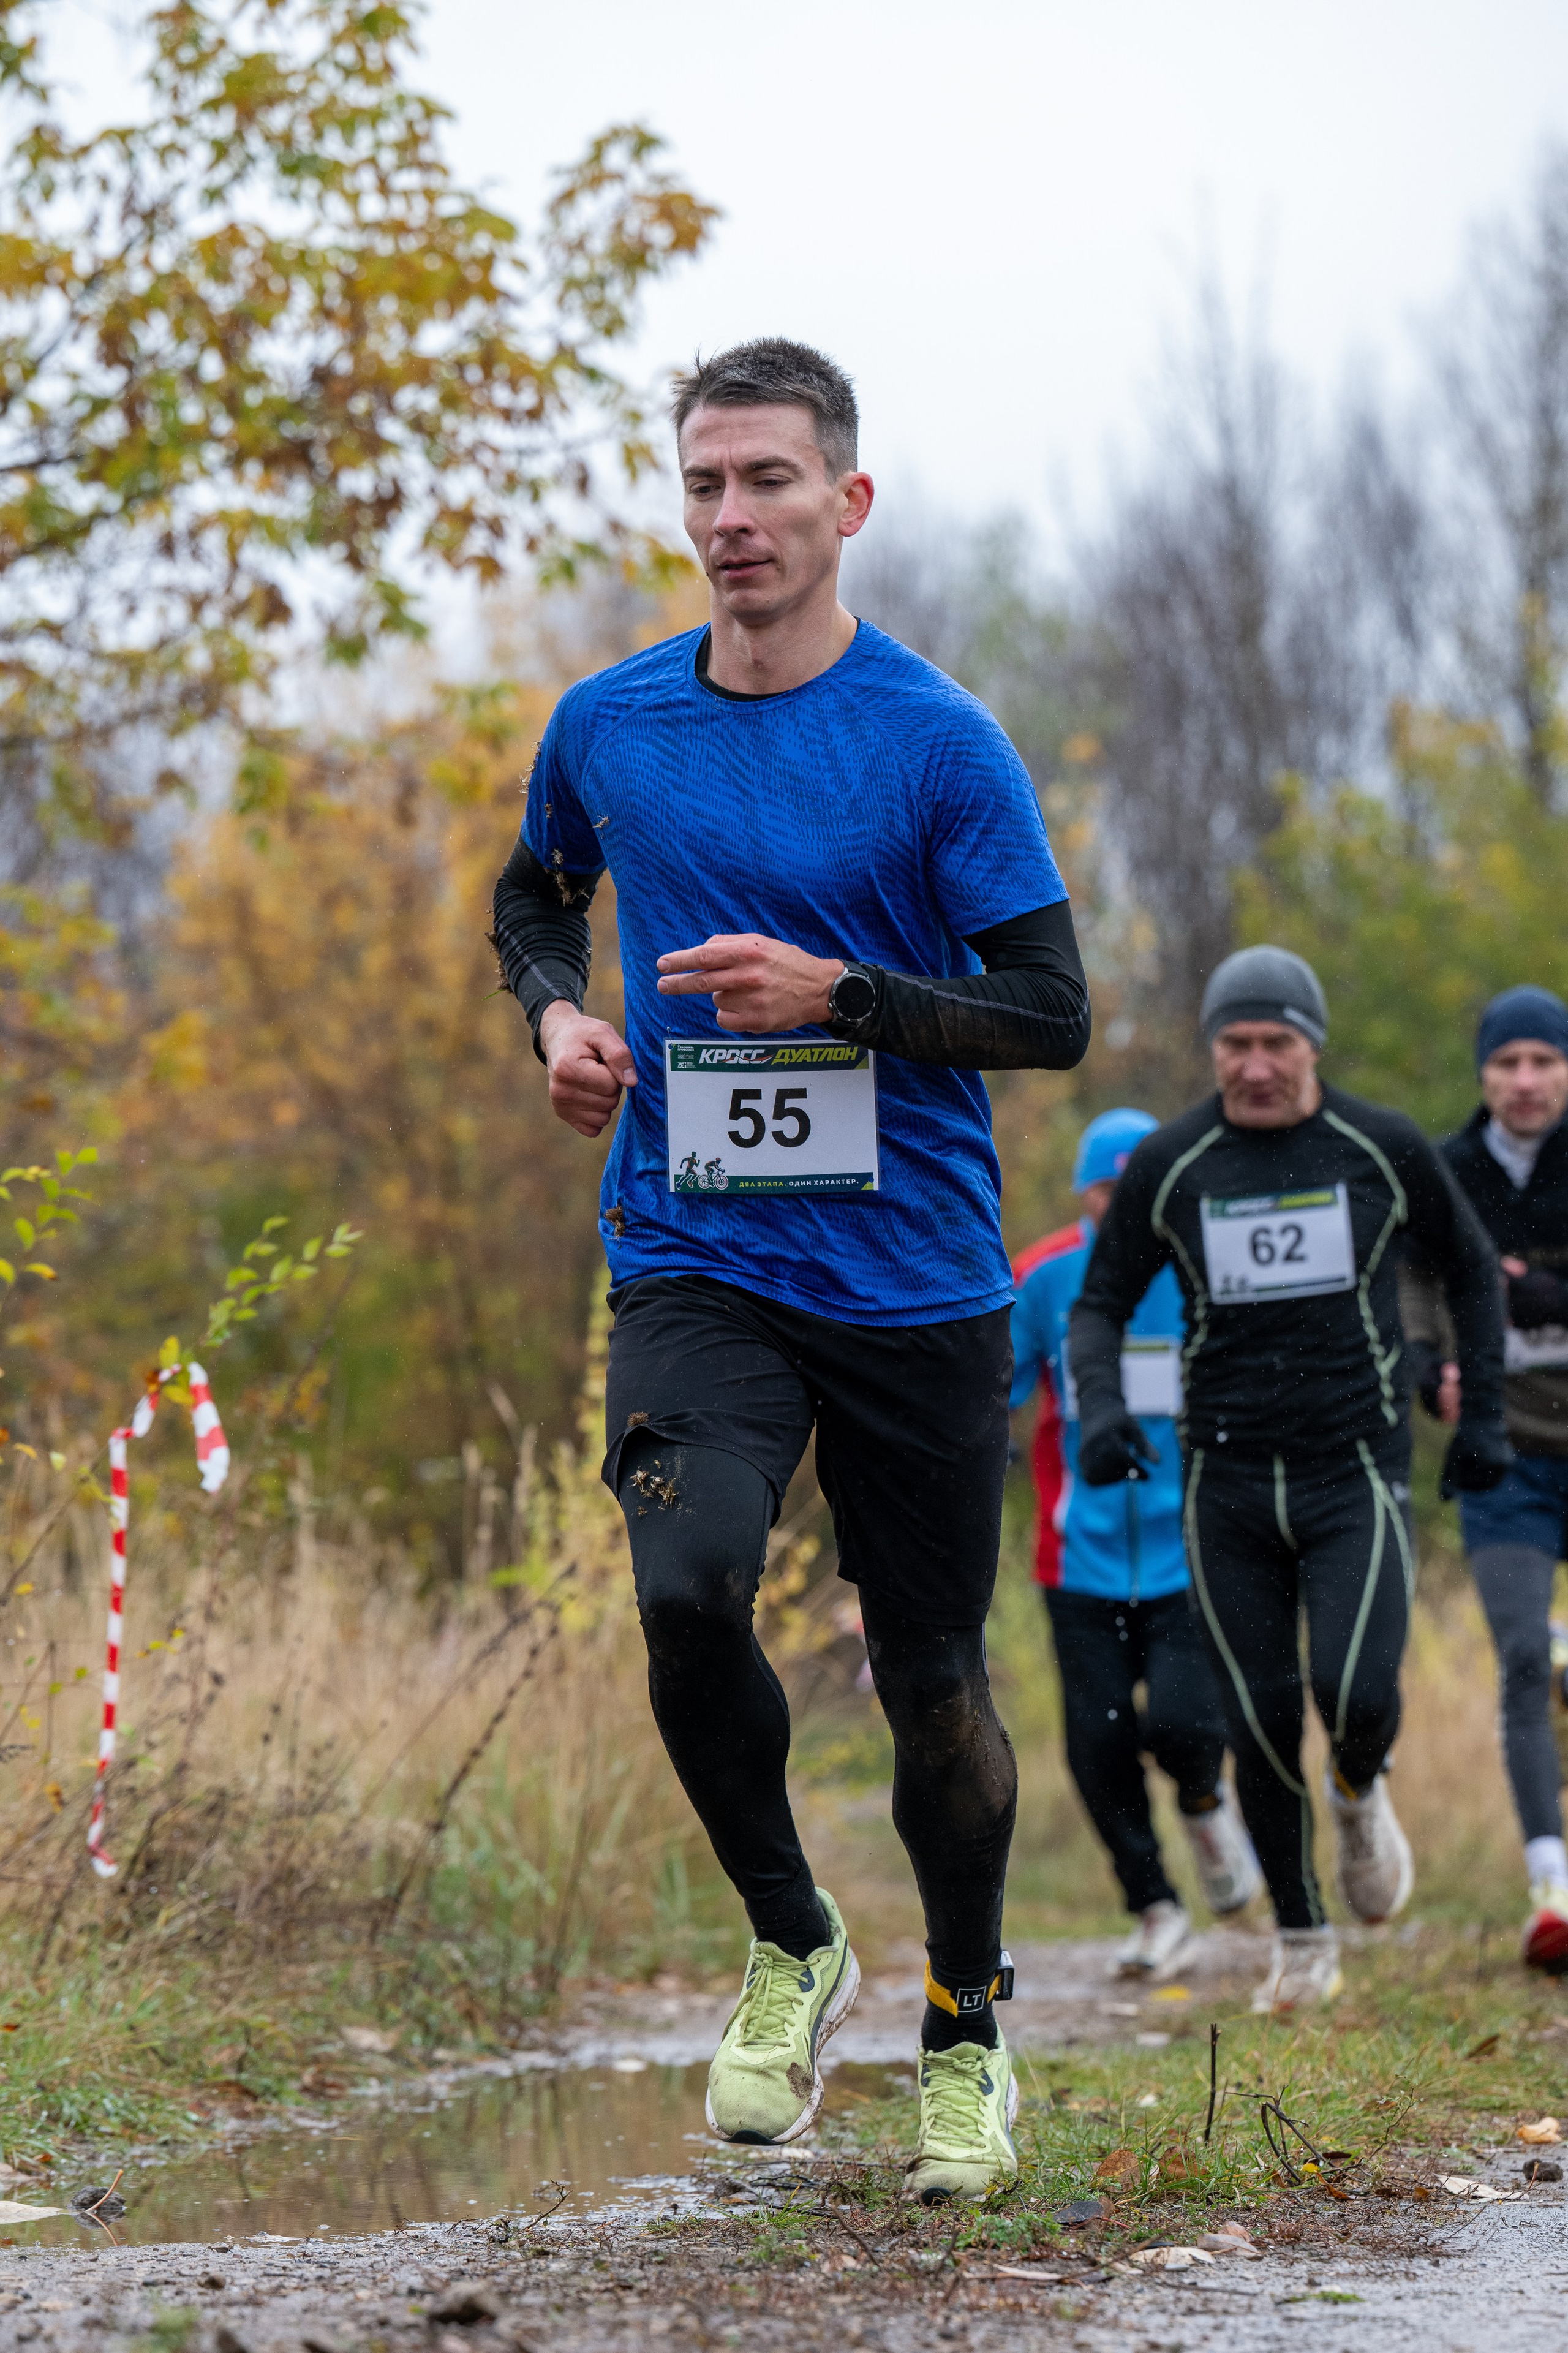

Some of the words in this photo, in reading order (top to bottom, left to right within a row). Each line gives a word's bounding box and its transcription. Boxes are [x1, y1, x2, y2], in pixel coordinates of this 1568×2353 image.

[699, 1049, 766, 1064] КРОСС
[771, 1046, 858, 1066] ДУАТЛОН
[728, 1088, 811, 1149] 55
[1250, 1224, 1305, 1266] 62
[963, 1993, 981, 2007] LT
